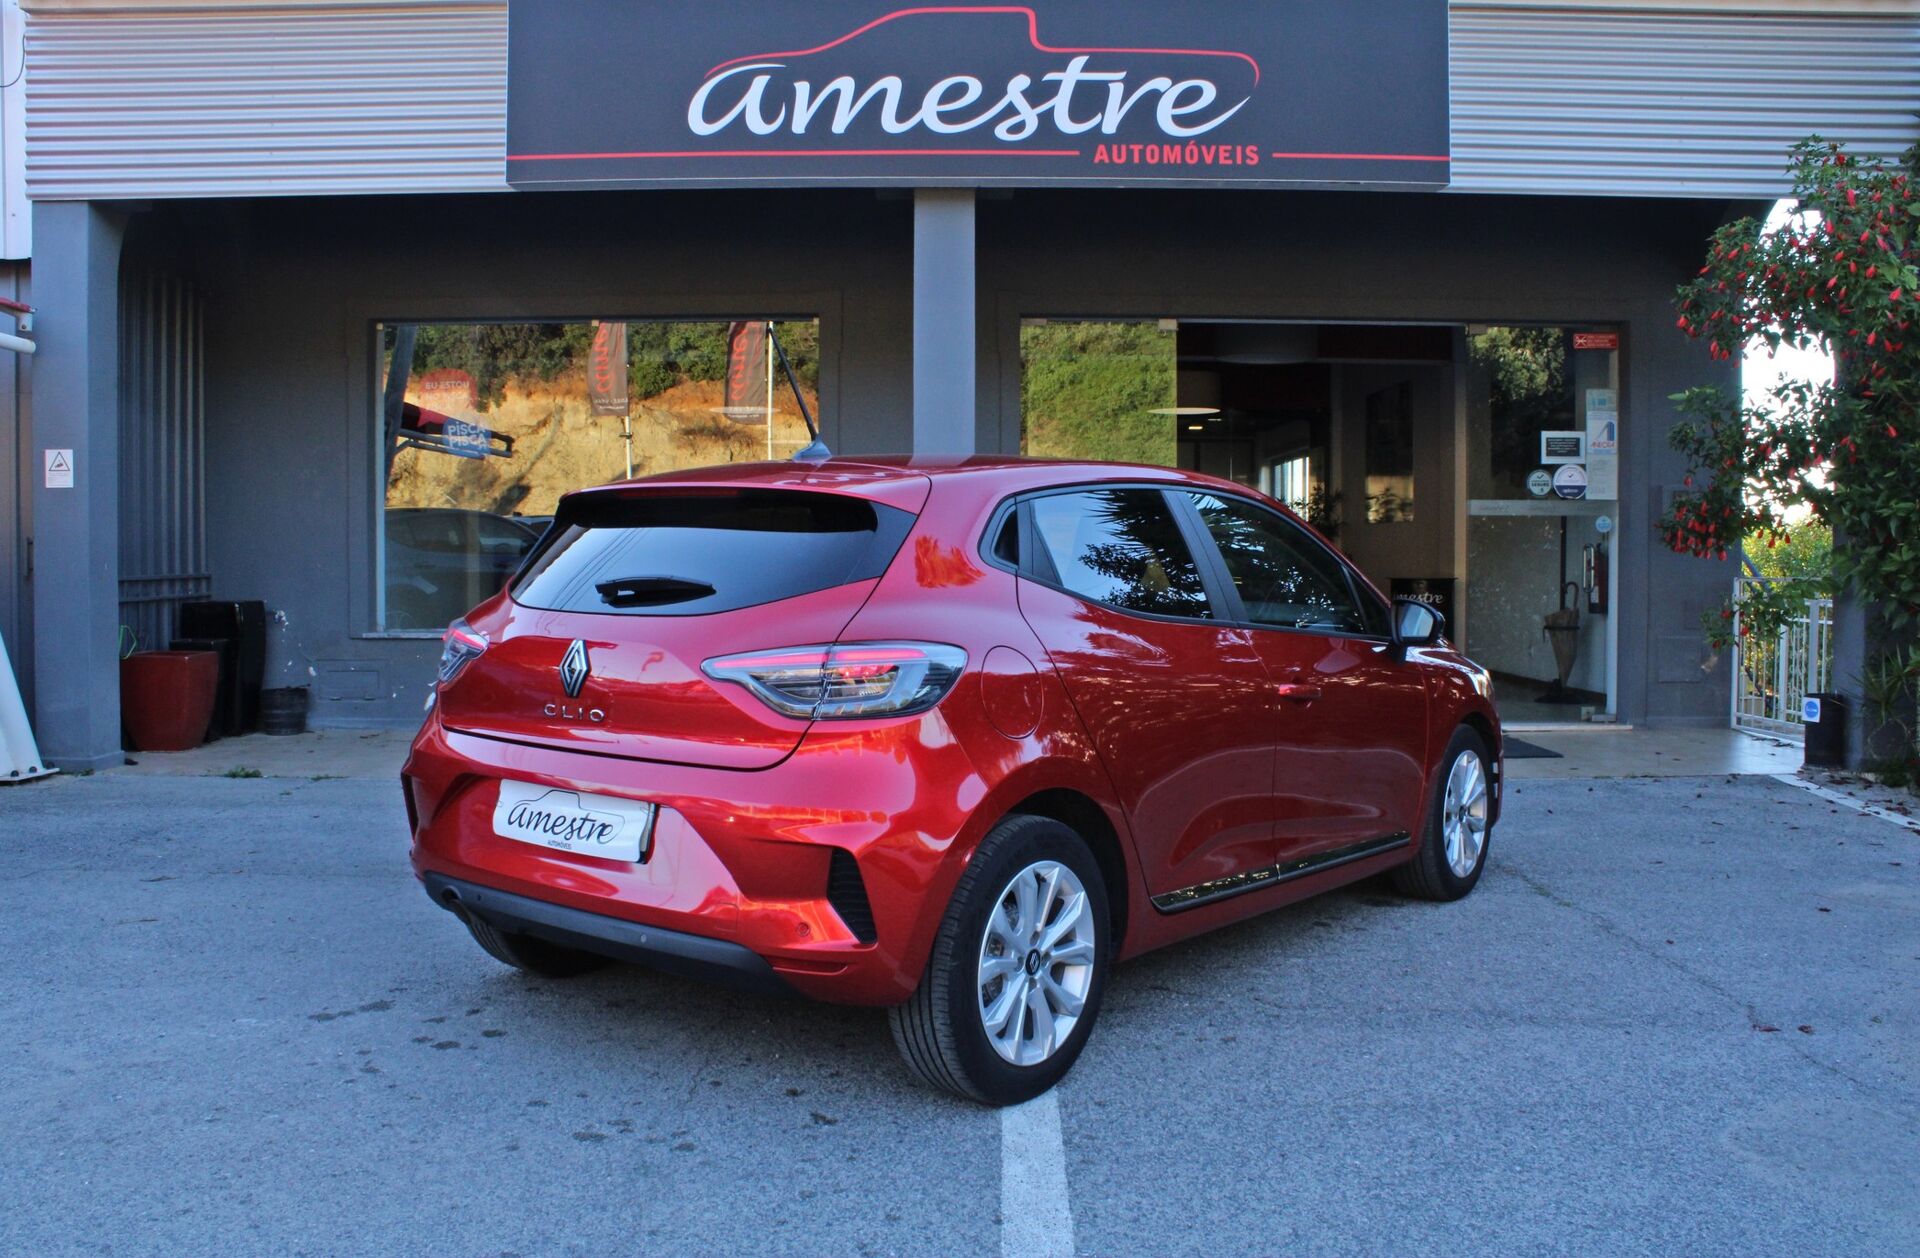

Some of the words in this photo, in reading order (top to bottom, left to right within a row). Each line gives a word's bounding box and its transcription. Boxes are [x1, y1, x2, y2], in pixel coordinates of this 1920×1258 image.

[687, 55, 1251, 142] amestre
[1093, 139, 1260, 166] AUTOMÓVEIS
[544, 703, 605, 722] CLIO
[507, 802, 616, 845] amestre
